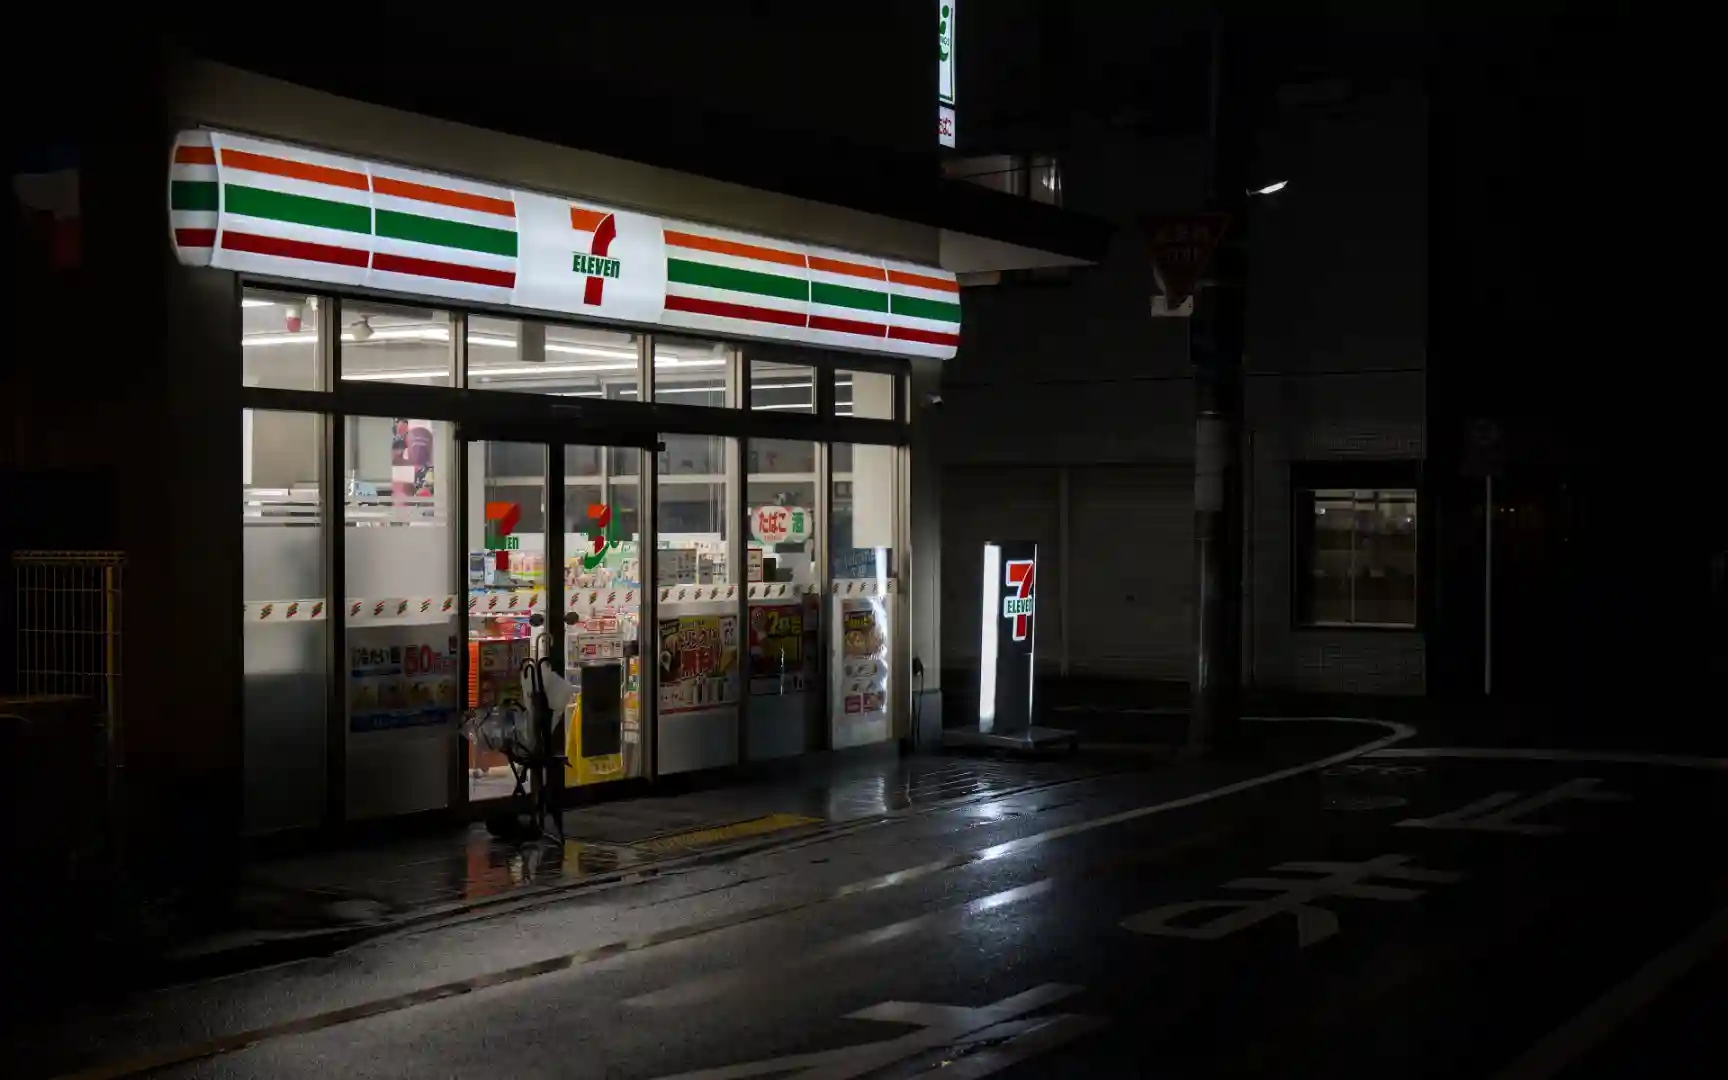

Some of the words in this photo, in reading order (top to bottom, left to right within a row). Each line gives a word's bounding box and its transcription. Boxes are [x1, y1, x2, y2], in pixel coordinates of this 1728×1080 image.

[570, 206, 616, 306] 7
[759, 511, 787, 533] たばこ
